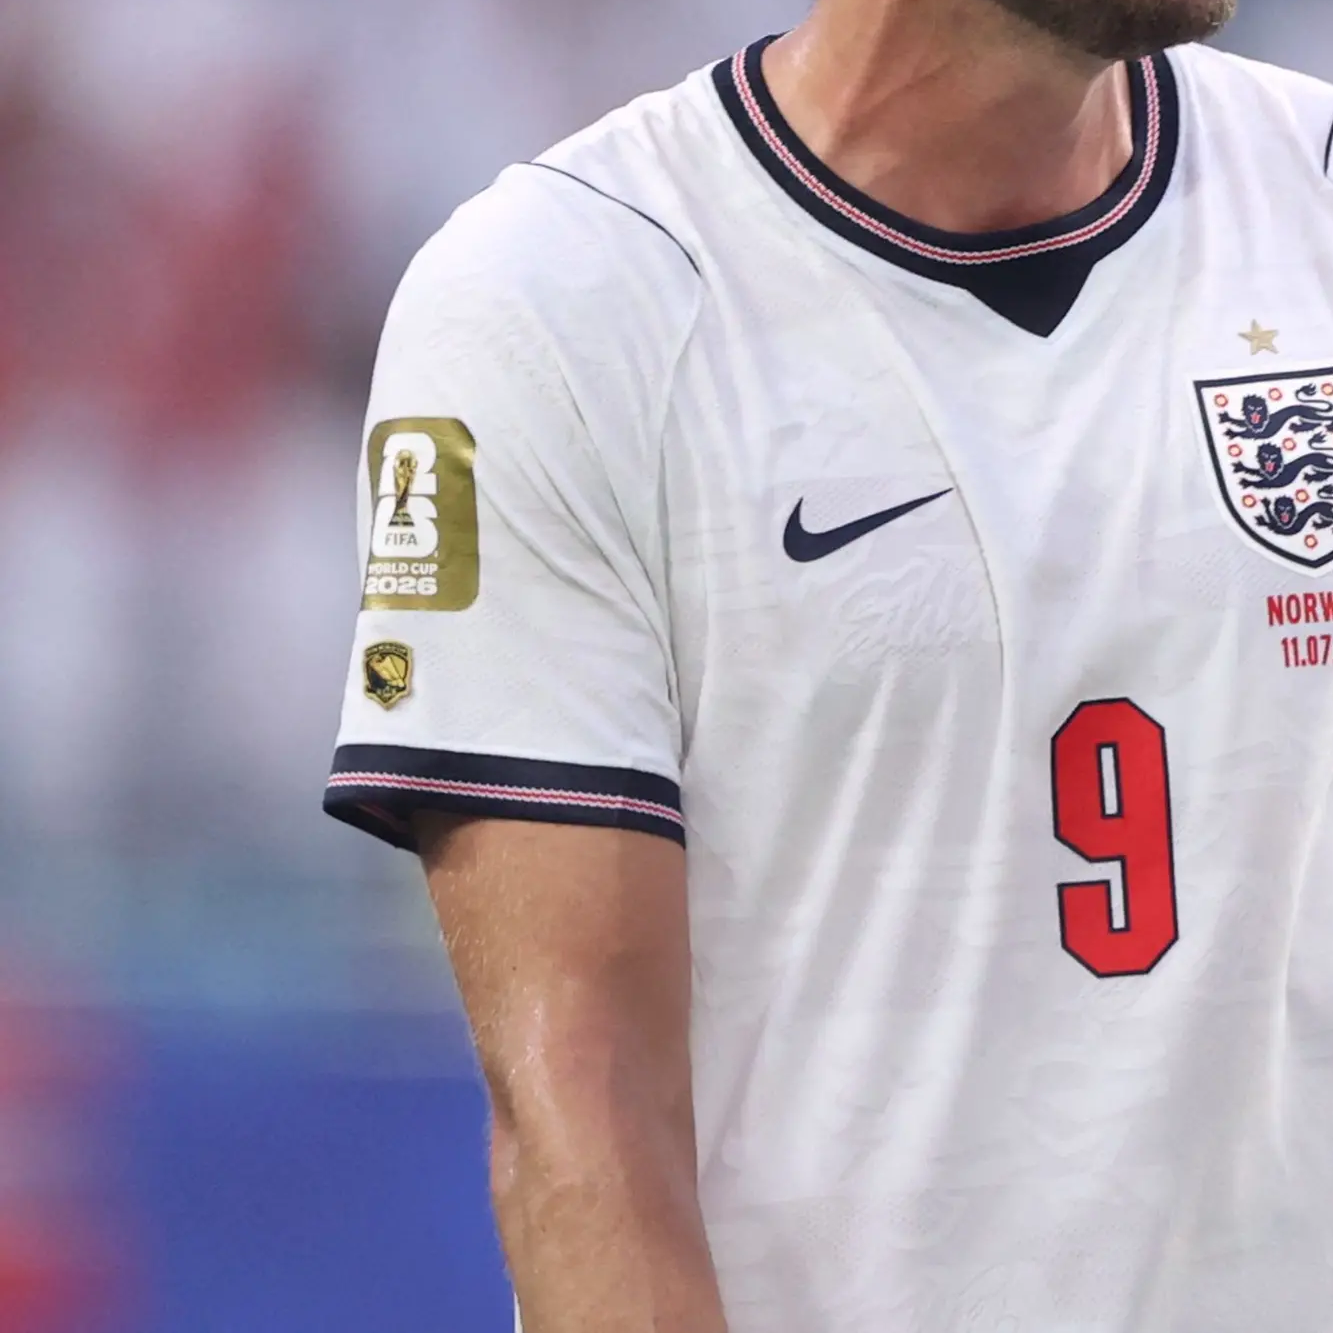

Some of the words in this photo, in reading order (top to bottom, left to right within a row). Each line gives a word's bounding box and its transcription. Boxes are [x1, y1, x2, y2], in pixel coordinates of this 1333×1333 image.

[385, 533, 418, 547] FIFA
[410, 563, 439, 575] CUP
[364, 576, 438, 596] 2026
[1050, 697, 1179, 979] 9
